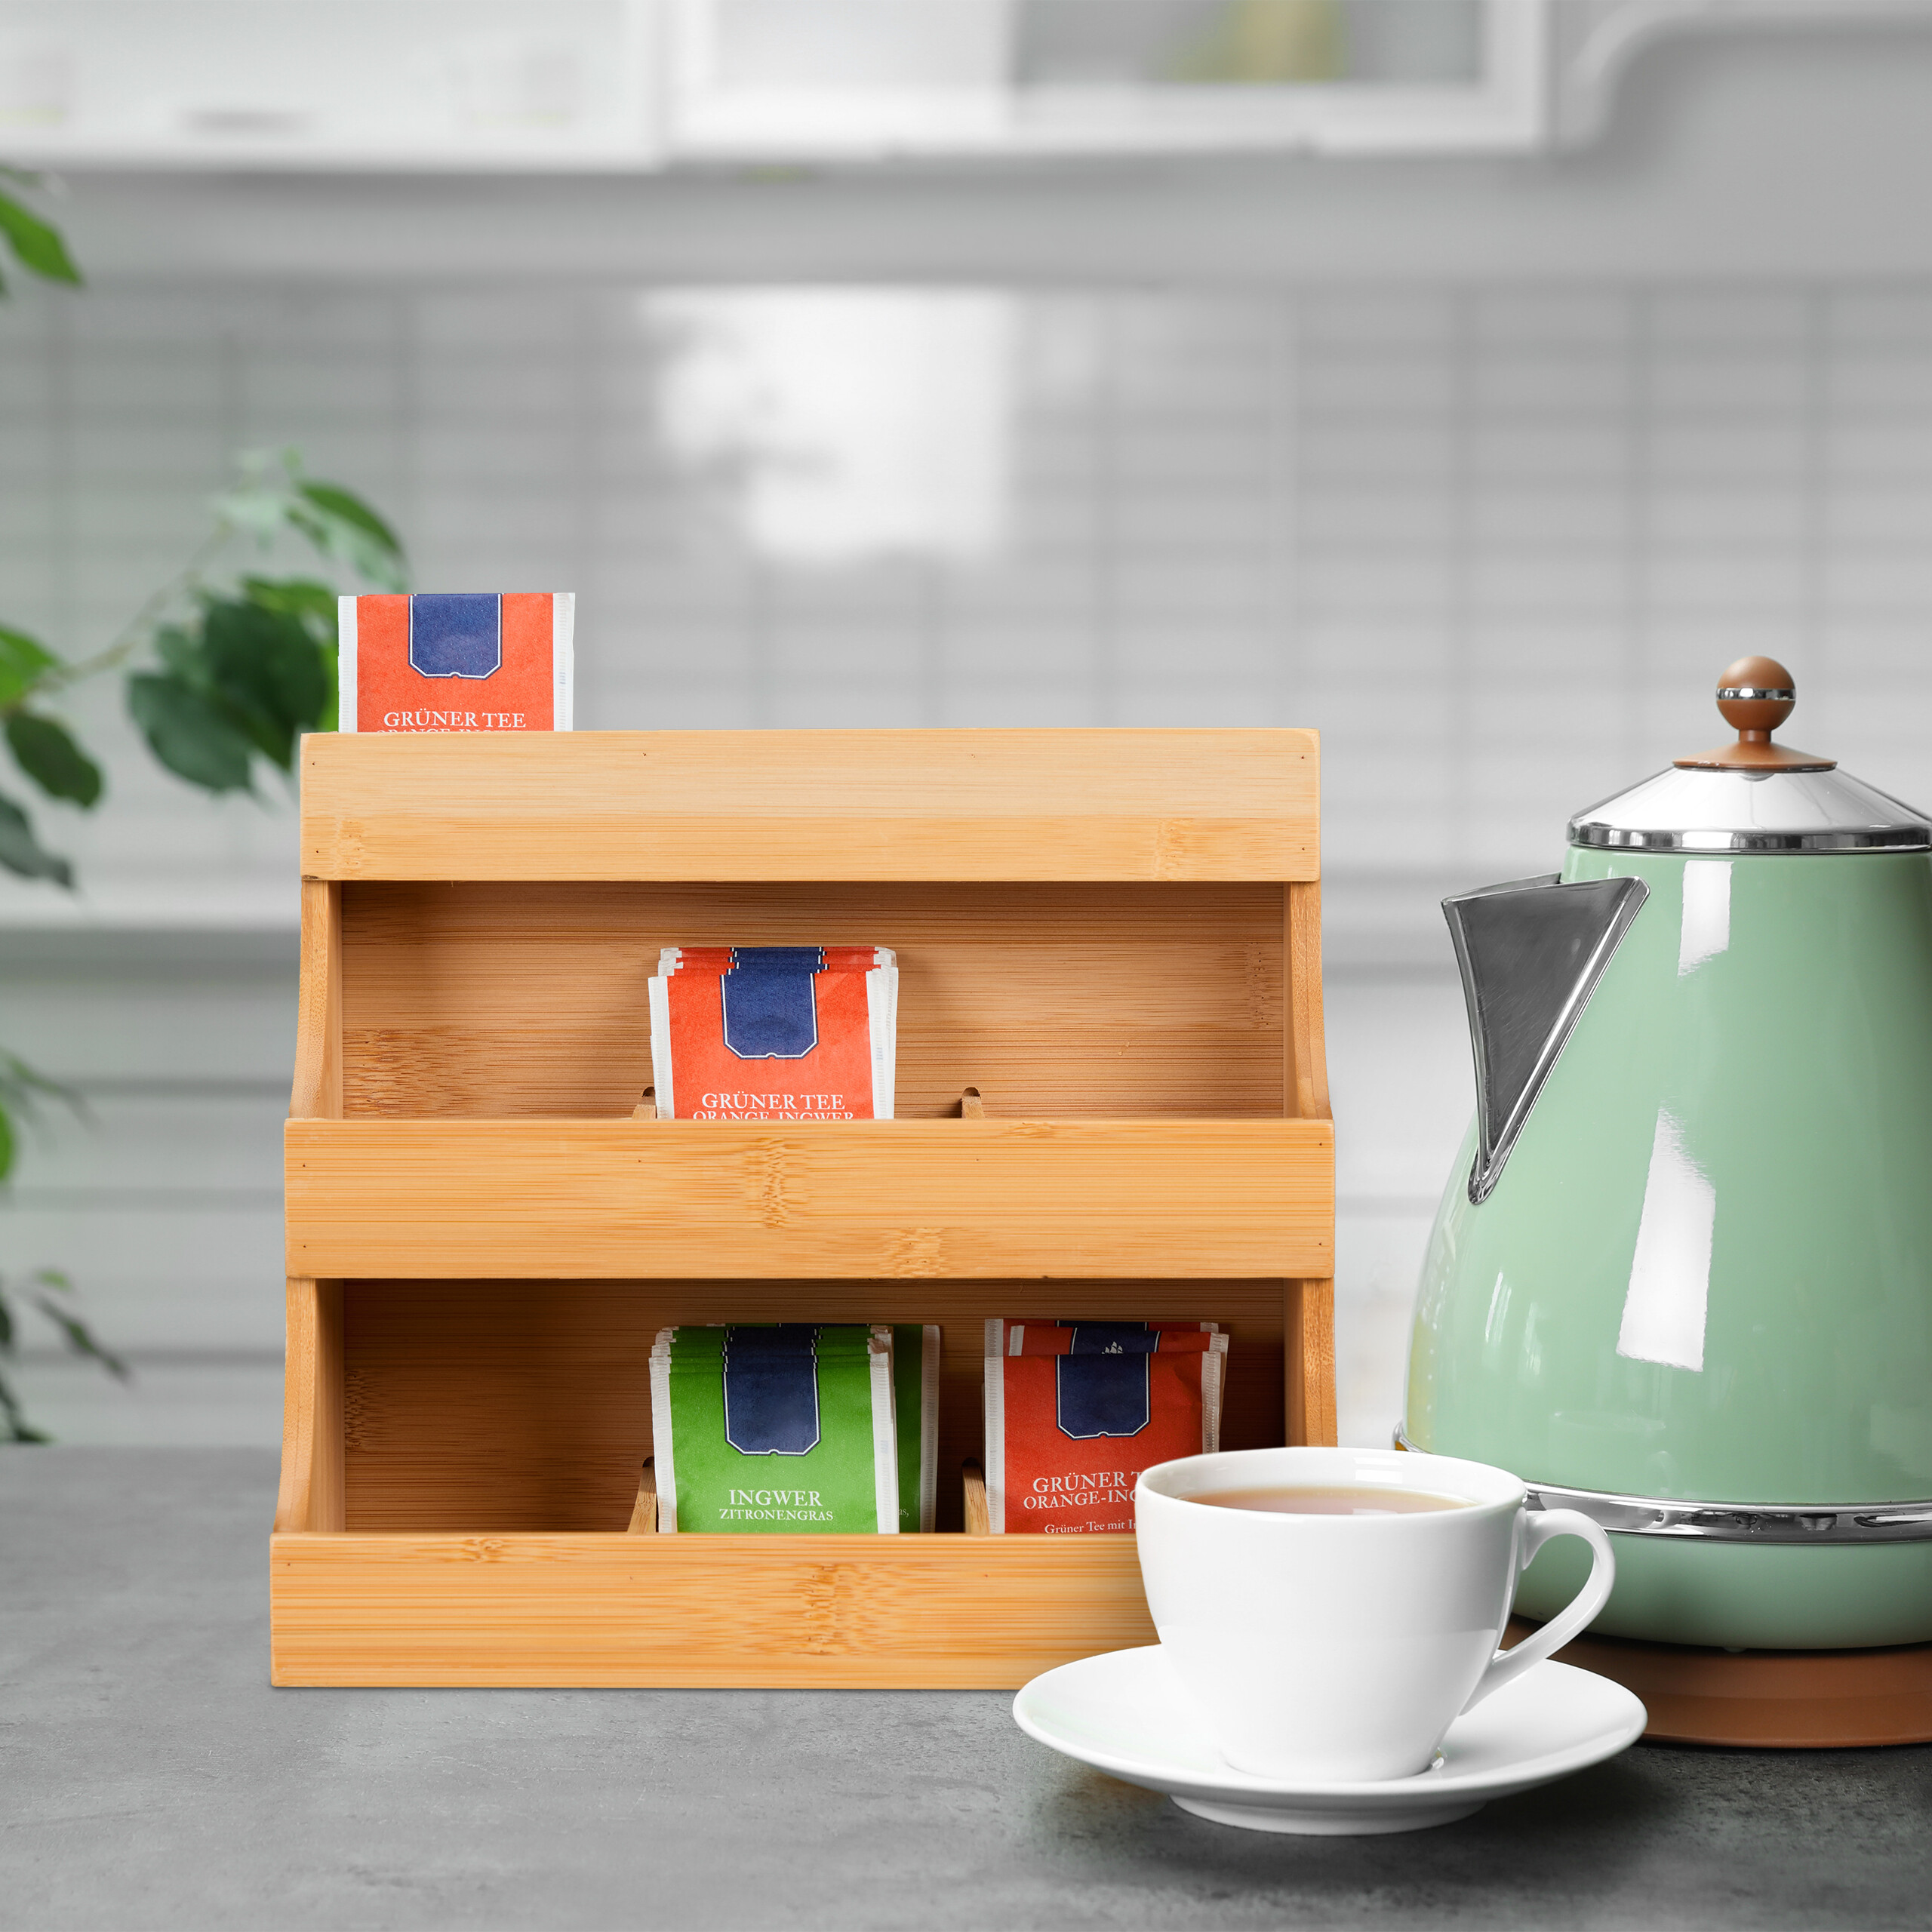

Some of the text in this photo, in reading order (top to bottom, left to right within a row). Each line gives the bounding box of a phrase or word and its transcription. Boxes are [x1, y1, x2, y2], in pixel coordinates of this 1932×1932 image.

[383, 708, 526, 728] GRÜNER TEE
[702, 1091, 845, 1110] GRÜNER TEE
[1032, 1472, 1127, 1493] GRÜNER
[728, 1489, 823, 1506] INGWER
[1023, 1489, 1136, 1509] ORANGE-IN
[719, 1509, 833, 1521] ZITRONENGRAS
[1044, 1524, 1084, 1534] Grüner
[1086, 1521, 1105, 1532] Tee
[1107, 1519, 1125, 1530] mit
